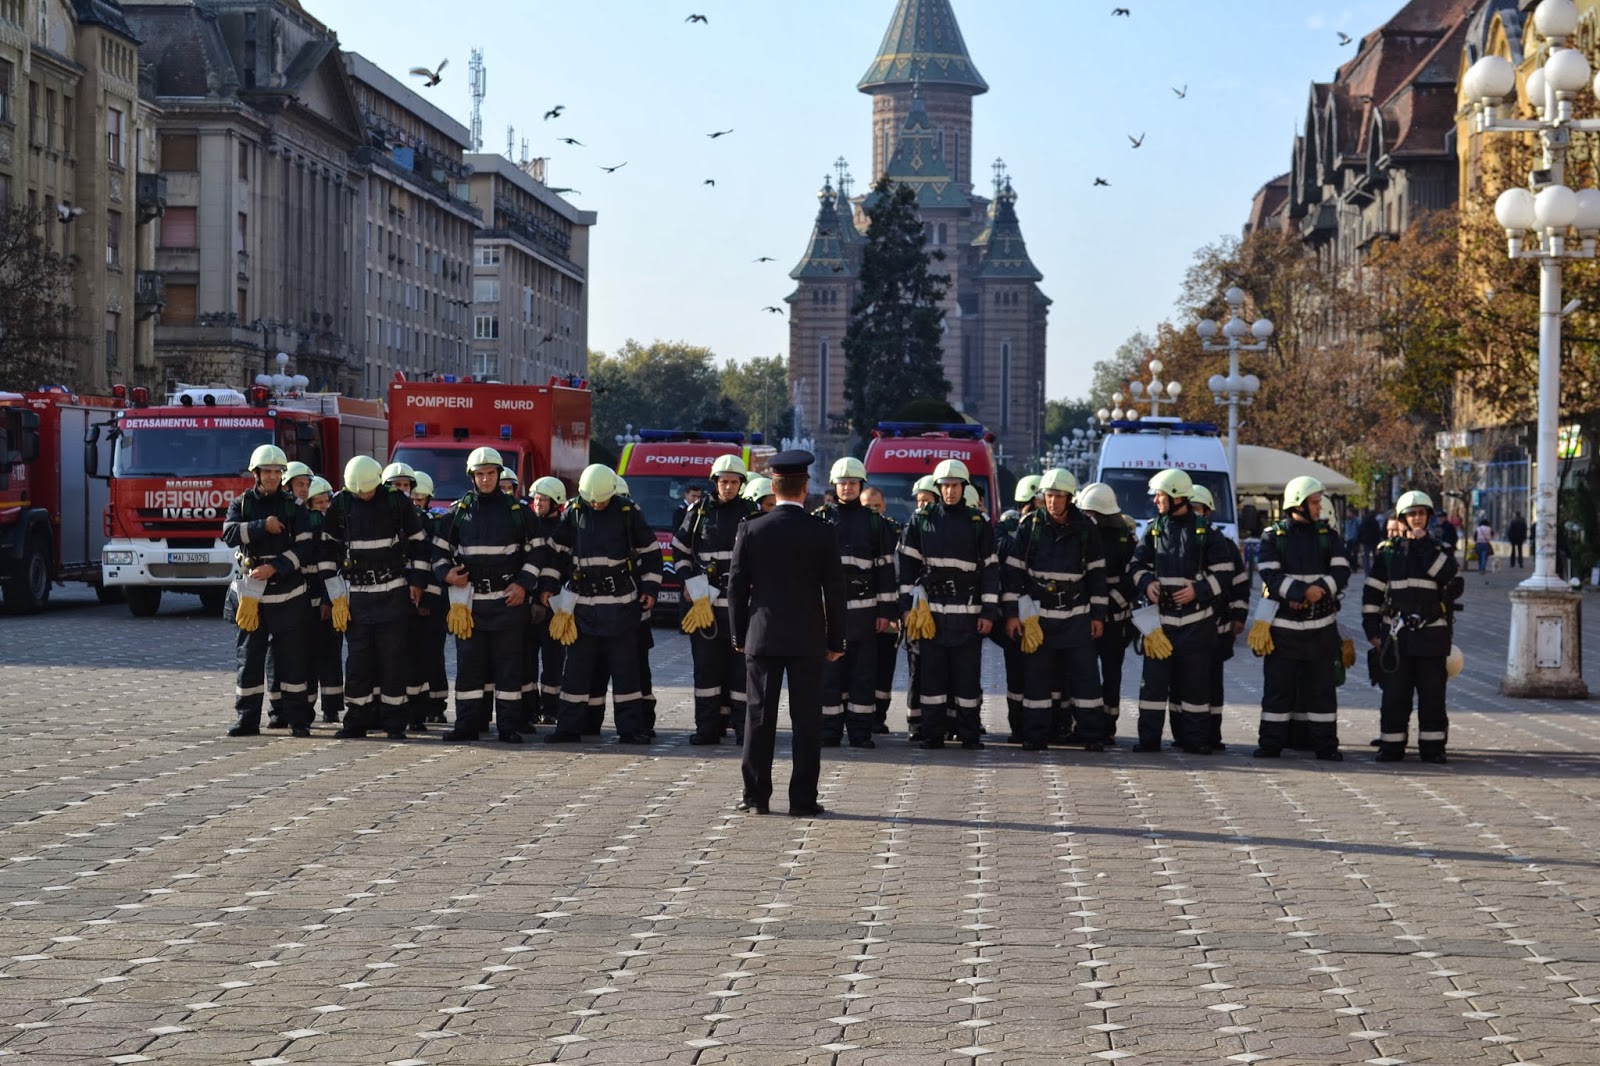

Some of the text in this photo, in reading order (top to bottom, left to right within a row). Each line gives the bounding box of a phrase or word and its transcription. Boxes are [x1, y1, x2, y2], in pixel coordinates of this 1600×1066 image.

[406, 396, 534, 411] POMPIERII SMURD
[126, 418, 264, 428] DETASAMENTUL 1 TIMISOARA
[645, 455, 716, 464] POMPIER
[885, 449, 971, 461] POMPIERII
[166, 480, 213, 488] MAGIRUS
[162, 507, 217, 519] IVECO
